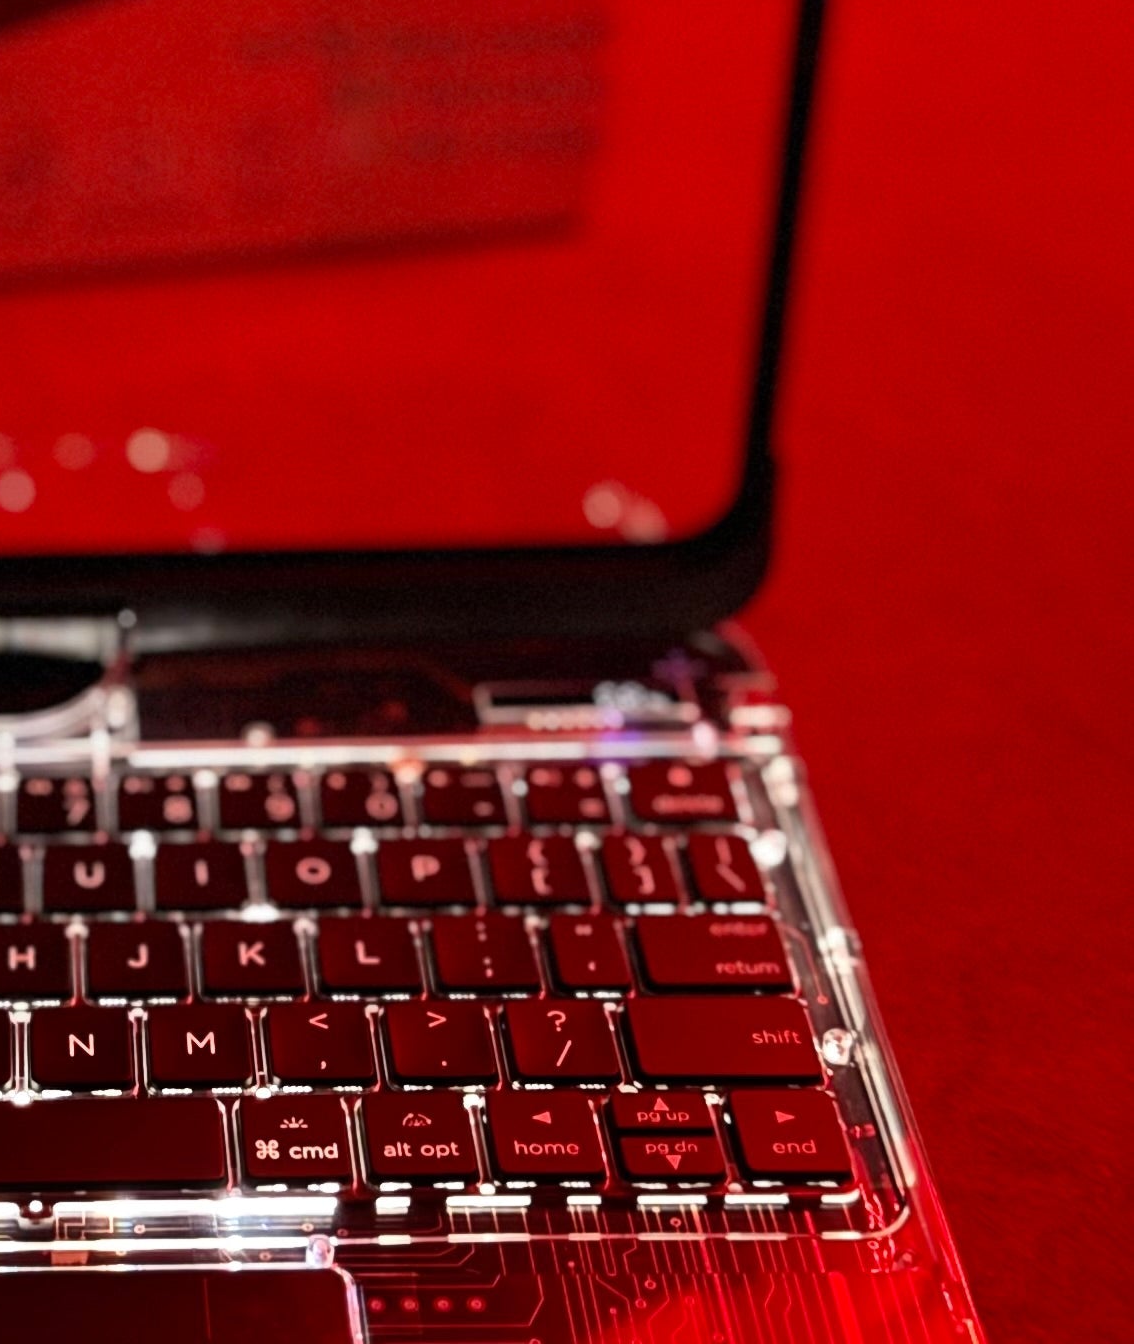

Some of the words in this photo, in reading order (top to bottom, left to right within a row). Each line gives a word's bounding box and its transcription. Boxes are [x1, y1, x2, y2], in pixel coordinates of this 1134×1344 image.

[73, 862, 105, 889] U
[295, 857, 331, 885] O
[411, 855, 440, 881] P
[8, 946, 36, 970] H
[127, 943, 149, 969] J
[238, 942, 265, 966] K
[355, 940, 380, 965] L
[715, 960, 781, 975] return
[68, 1033, 95, 1057] N
[186, 1031, 216, 1055] M
[751, 1029, 802, 1044] shift
[636, 1111, 661, 1123] pg
[666, 1111, 690, 1123] up
[288, 1142, 339, 1160] cmd
[383, 1141, 413, 1158] alt
[420, 1141, 460, 1159] opt
[513, 1140, 579, 1156] home
[645, 1143, 669, 1155] pg
[674, 1140, 698, 1153] dn
[772, 1139, 817, 1154] end
